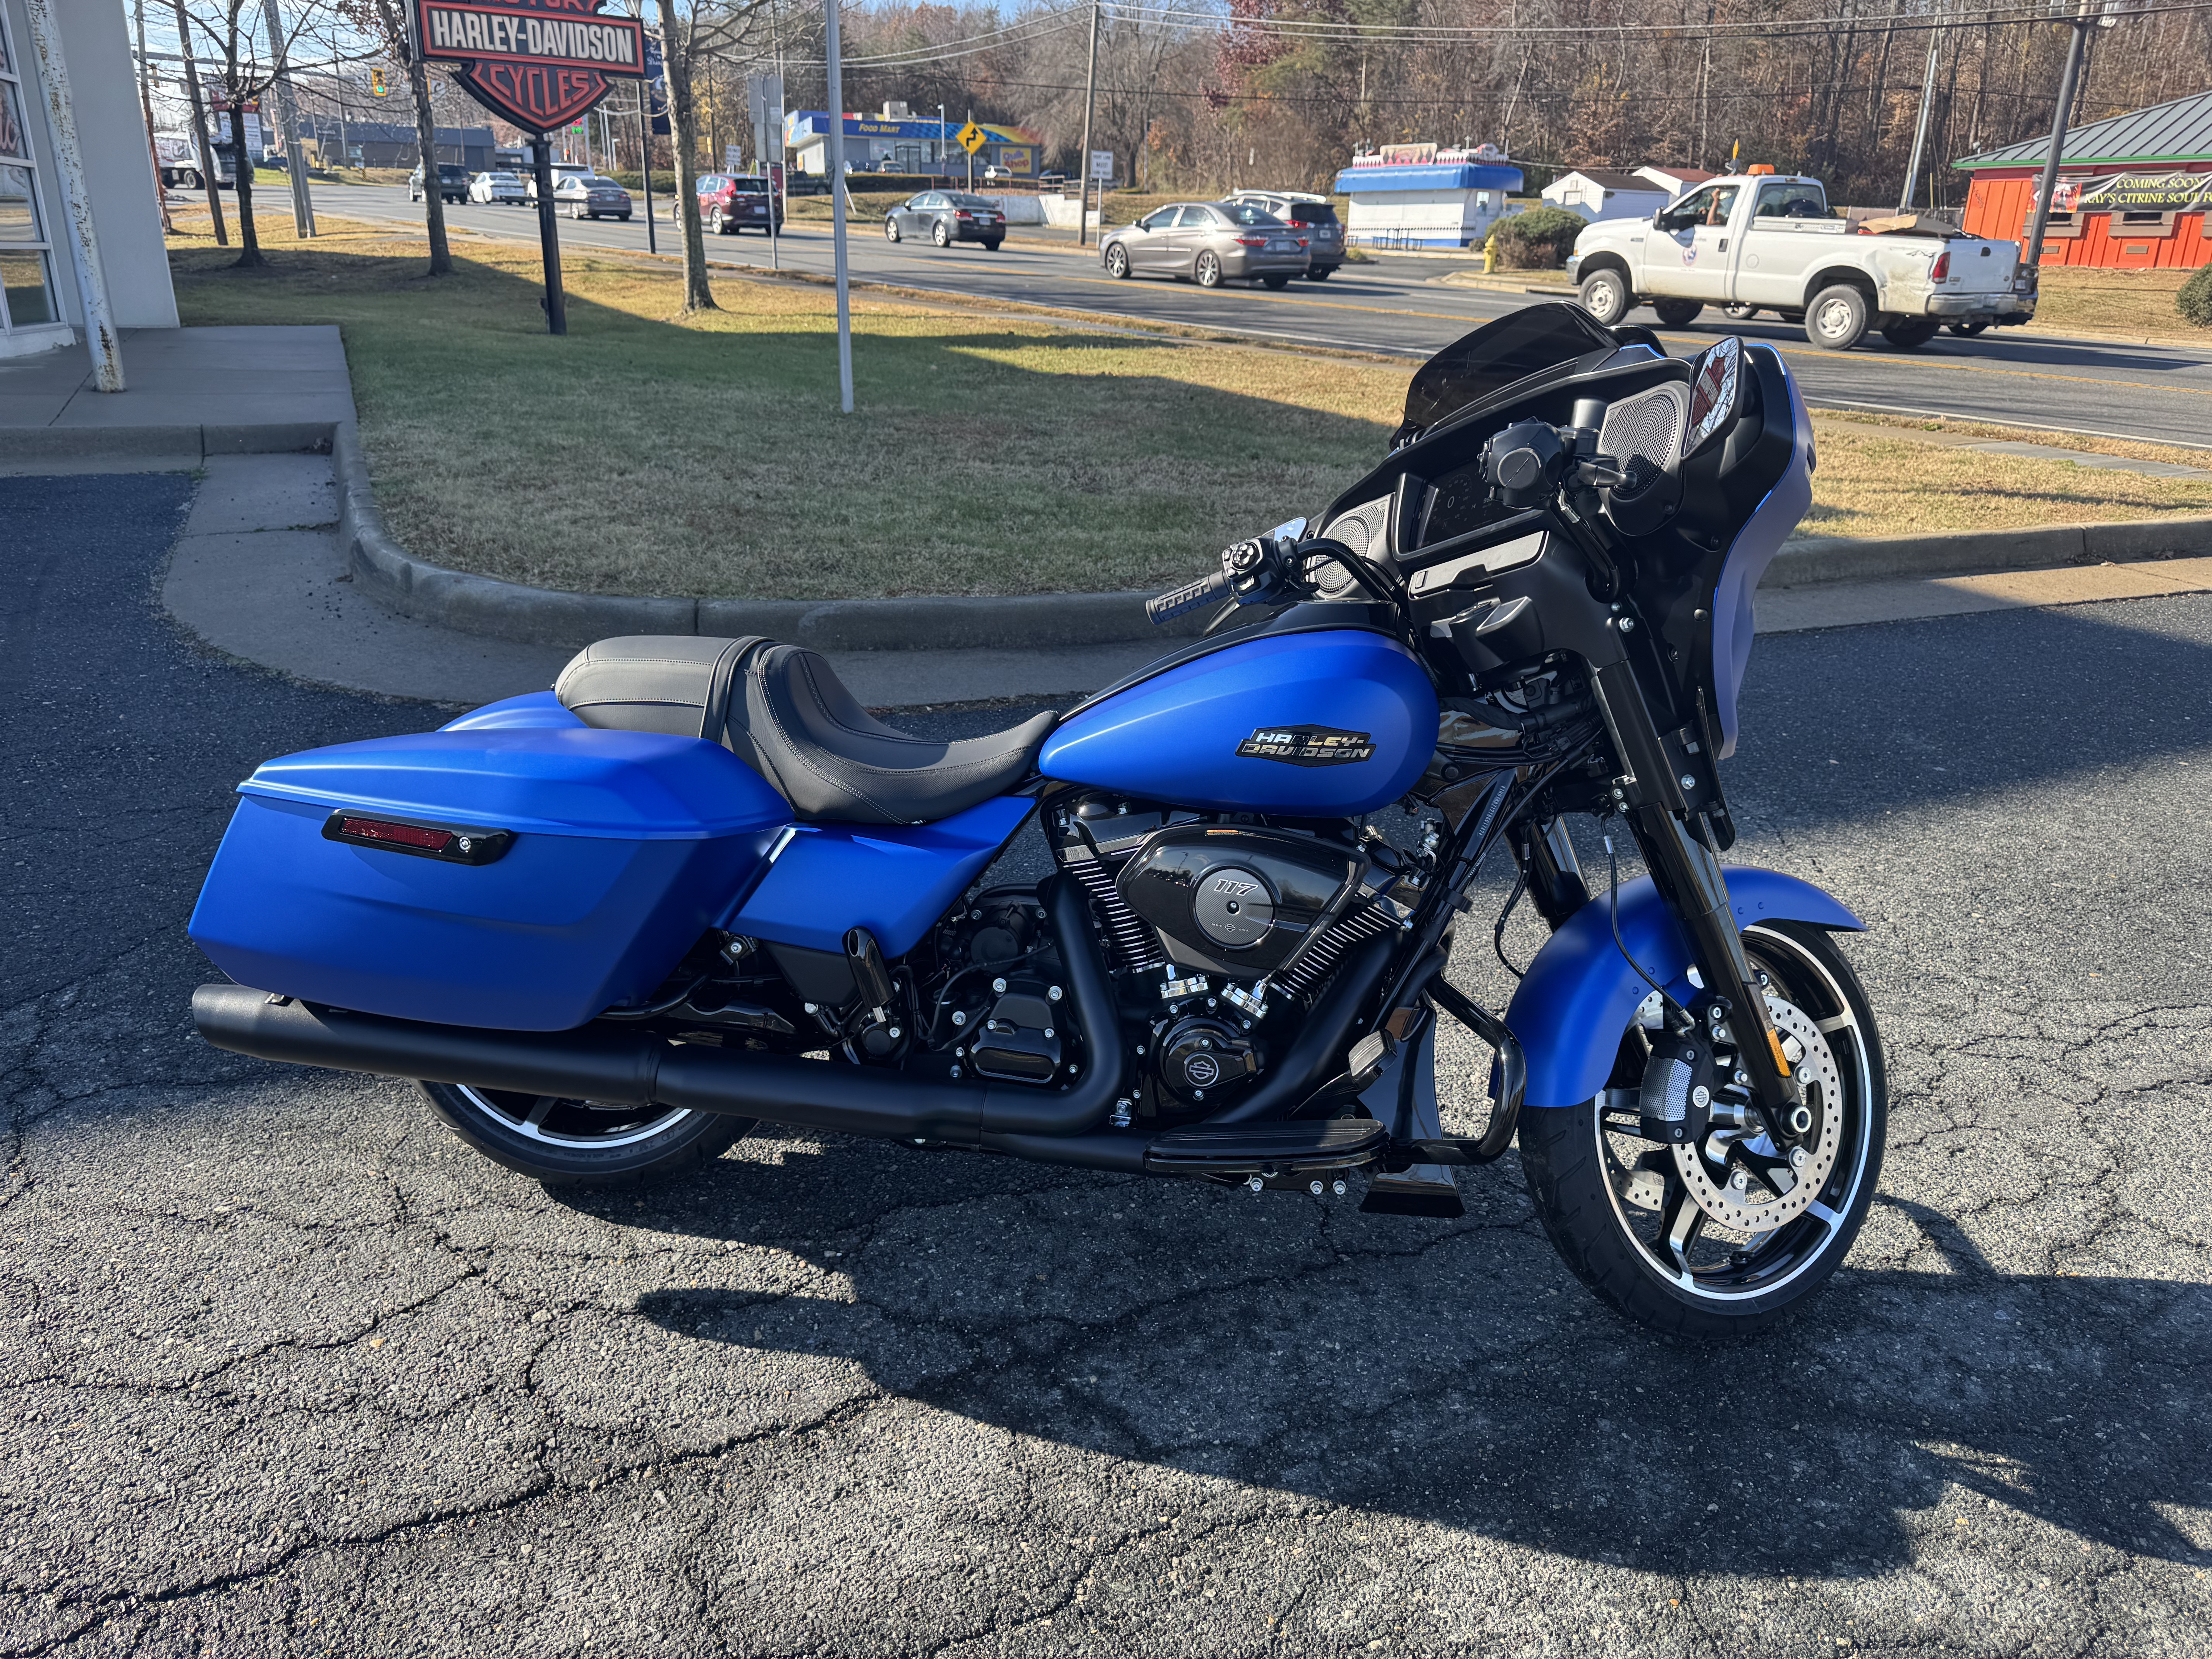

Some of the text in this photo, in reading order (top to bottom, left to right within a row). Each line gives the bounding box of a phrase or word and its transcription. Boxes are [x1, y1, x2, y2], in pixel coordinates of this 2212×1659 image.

[431, 10, 633, 64] HARLEY-DAVIDSON
[489, 64, 590, 117] CYCLES
[859, 123, 900, 134] FOOD MART
[2116, 178, 2166, 189] COMING
[2118, 192, 2166, 203] CITRINE
[2167, 192, 2199, 203] SOUL
[1255, 732, 1364, 747] HARLEY-
[1242, 743, 1370, 758] DAVIDSON
[1214, 879, 1258, 896] 117
